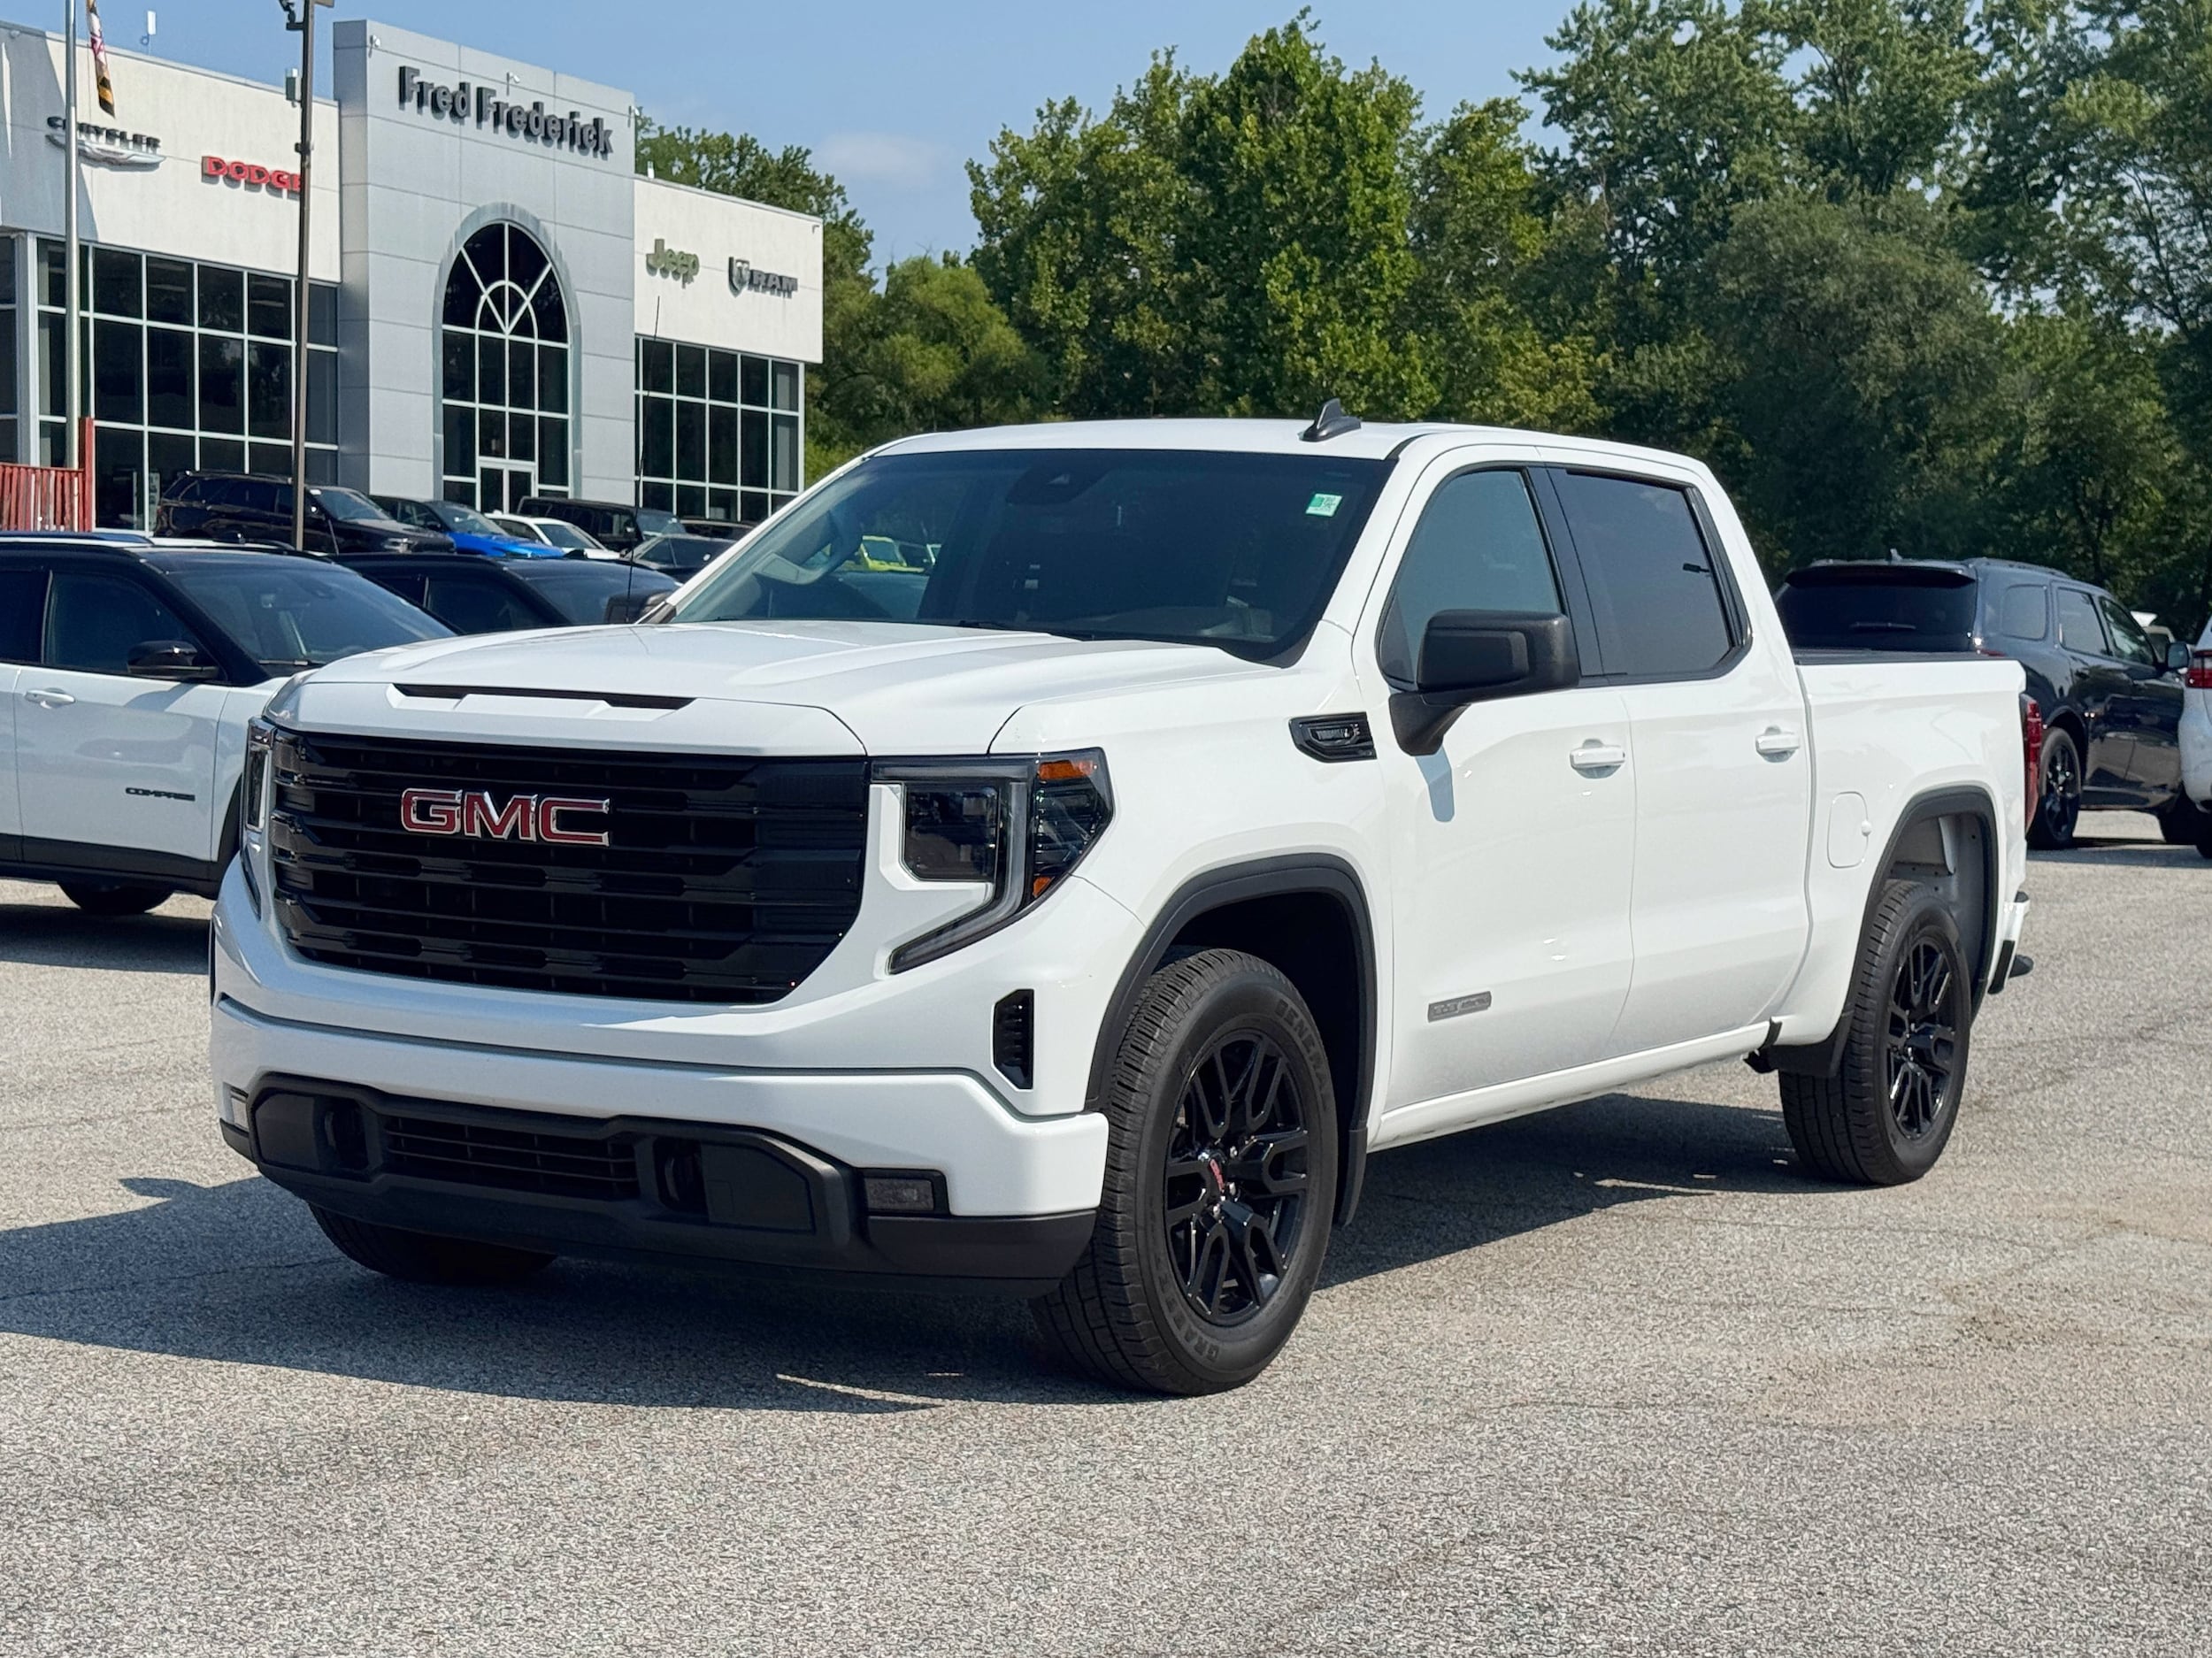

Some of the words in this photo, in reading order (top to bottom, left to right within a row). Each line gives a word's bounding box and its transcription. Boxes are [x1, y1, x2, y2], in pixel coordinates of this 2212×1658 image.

[47, 116, 160, 150] CRYSLER
[398, 65, 472, 119] Fred
[476, 86, 614, 156] Frederick
[646, 238, 700, 285] Jeep
[749, 269, 798, 295] RAM
[401, 787, 611, 847] GMC
